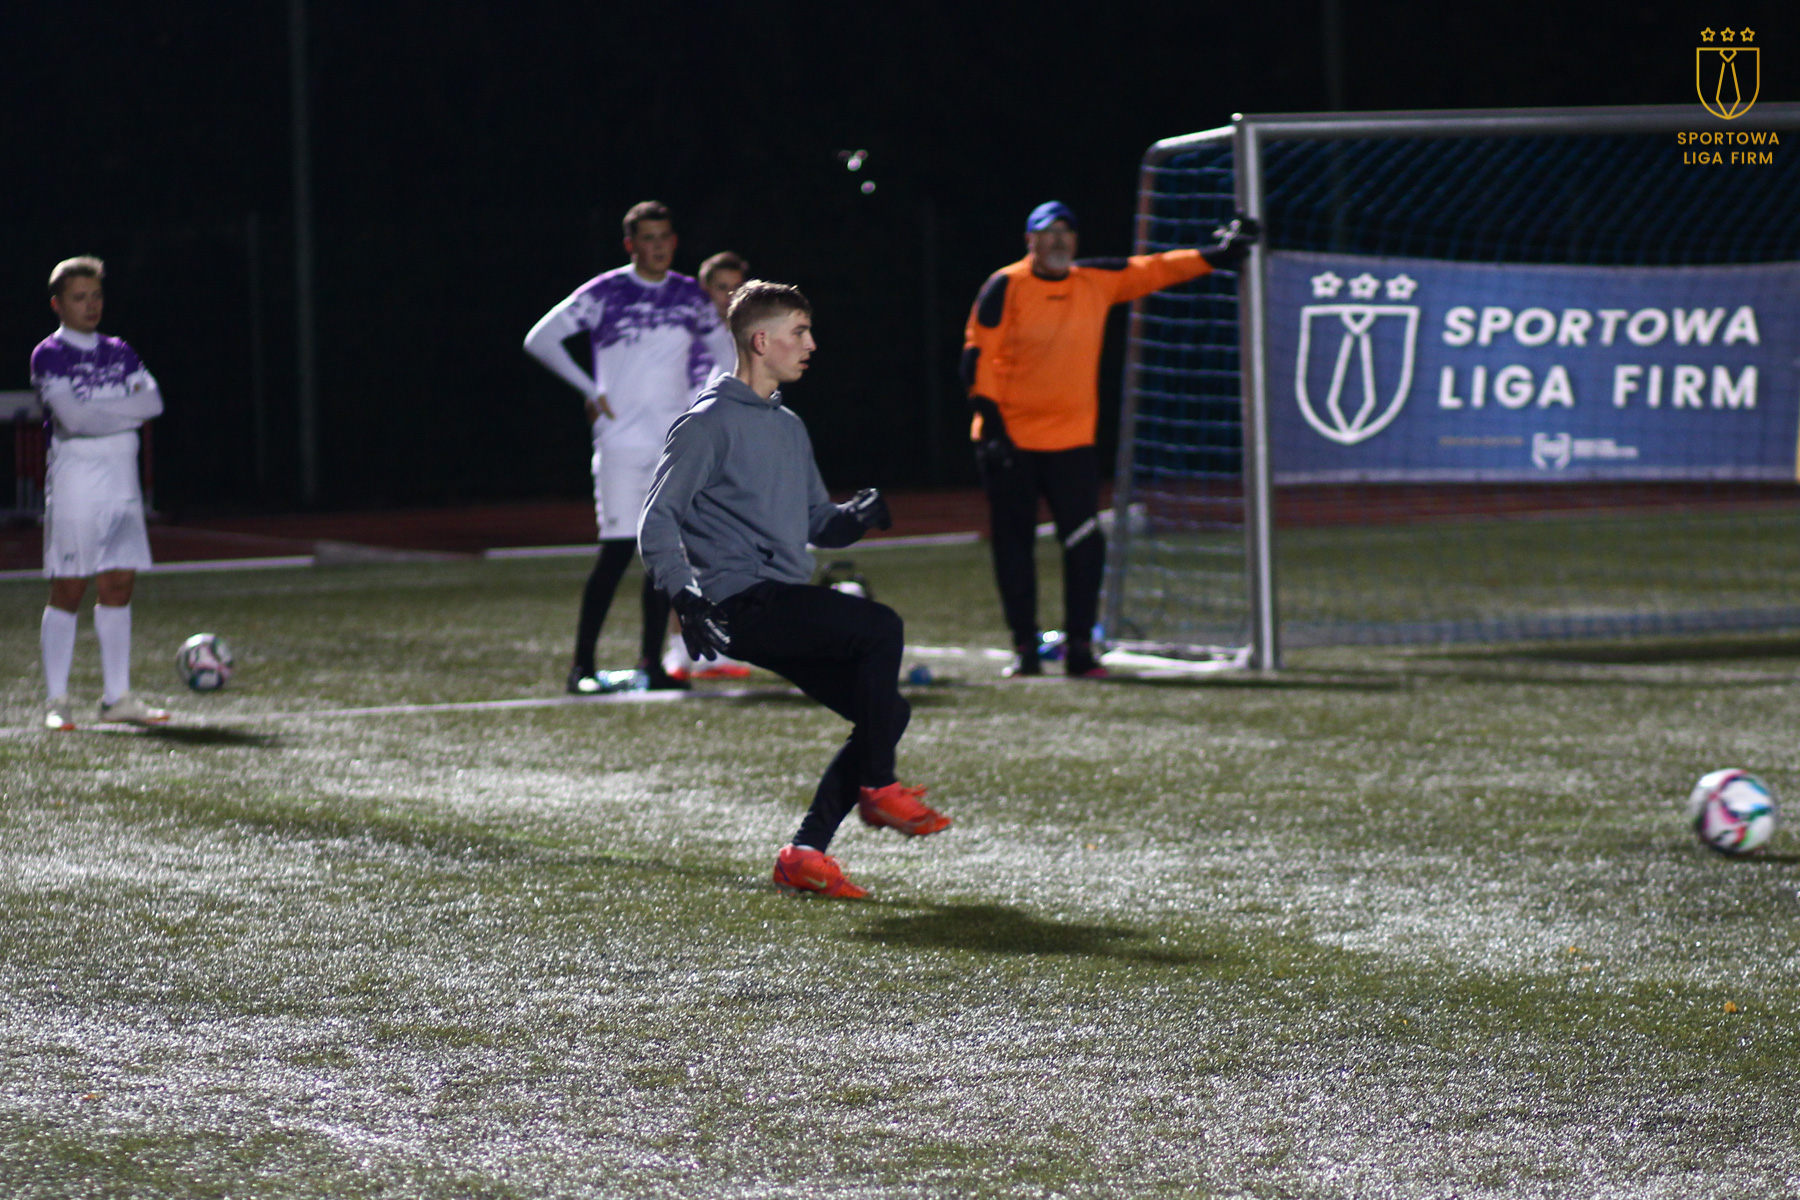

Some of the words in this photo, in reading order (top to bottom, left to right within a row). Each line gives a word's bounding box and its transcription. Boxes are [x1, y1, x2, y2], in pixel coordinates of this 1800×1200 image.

[1442, 306, 1760, 347] SPORTOWA
[1438, 365, 1574, 409] LIGA
[1612, 365, 1758, 409] FIRM
